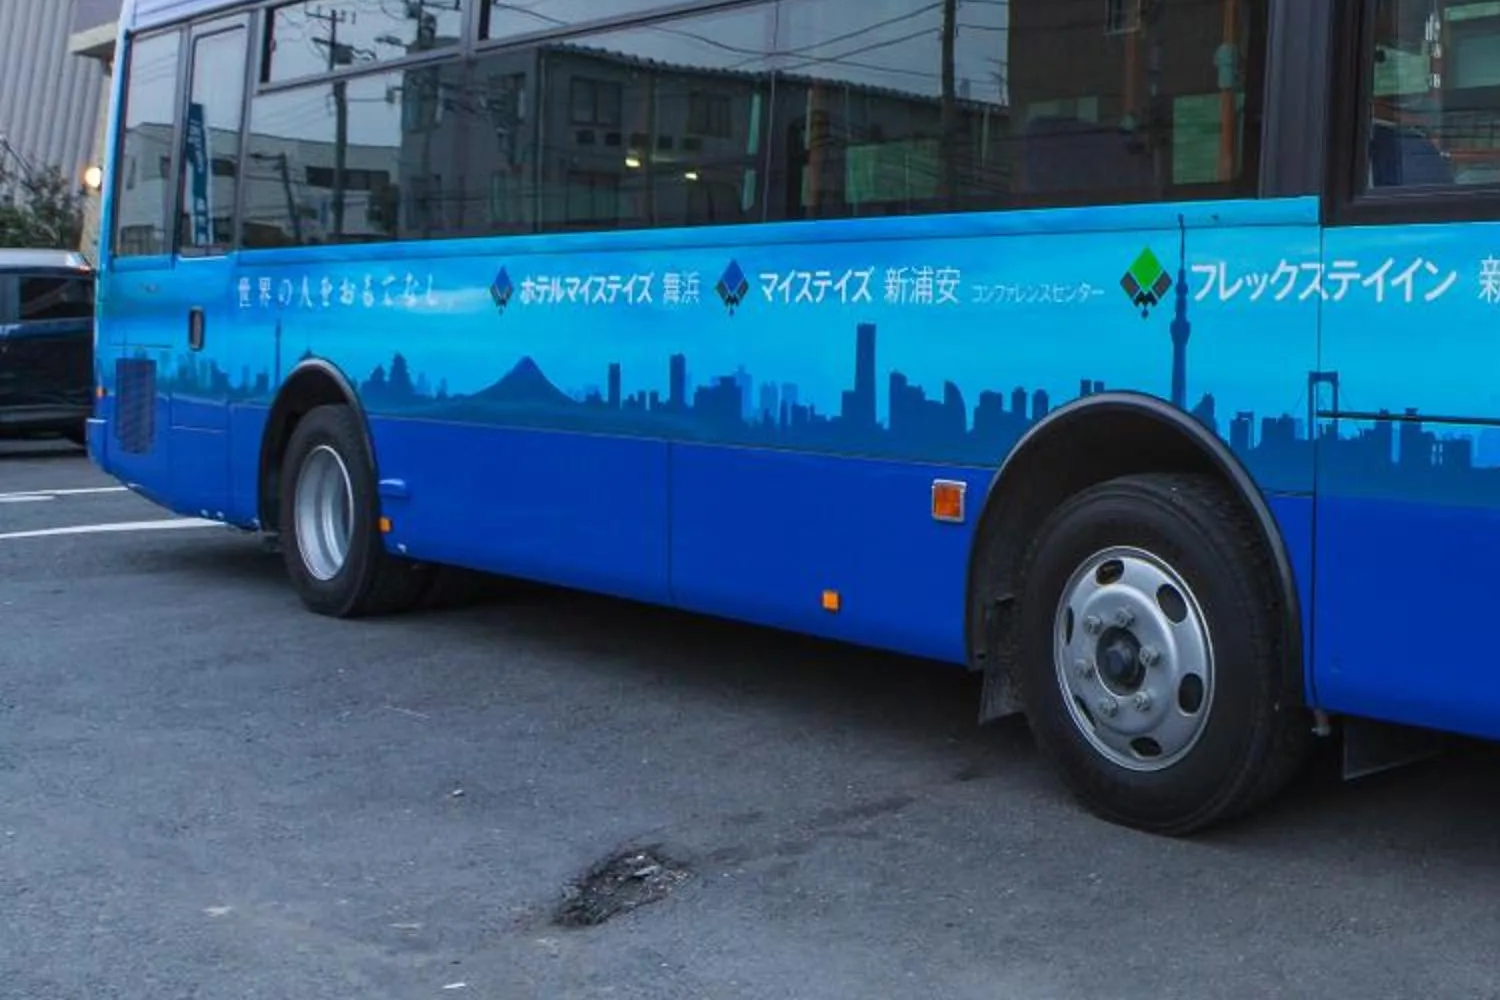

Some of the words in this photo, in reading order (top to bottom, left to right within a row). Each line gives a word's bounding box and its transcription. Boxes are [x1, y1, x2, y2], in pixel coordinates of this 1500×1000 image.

[520, 272, 654, 304] ホテルマイステイズ
[759, 266, 875, 303] マイステイズ
[883, 266, 961, 304] 新浦安
[1190, 257, 1458, 303] フレックステイイン
